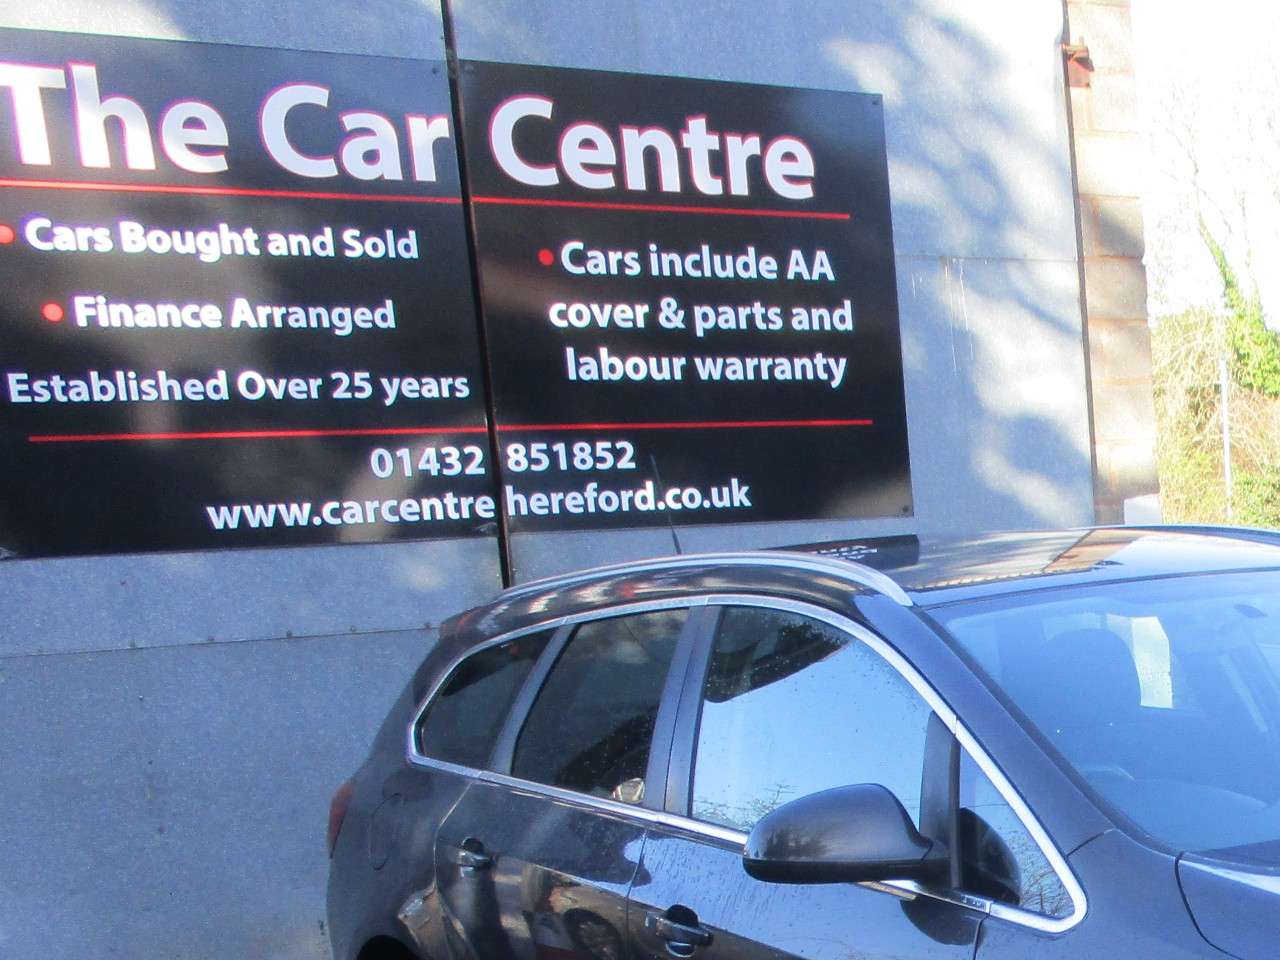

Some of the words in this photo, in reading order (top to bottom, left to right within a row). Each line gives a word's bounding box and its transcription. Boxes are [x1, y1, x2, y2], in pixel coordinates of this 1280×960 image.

[0, 63, 229, 174] The
[260, 83, 450, 182] Car
[489, 96, 815, 201] Centre
[24, 218, 111, 253] Cars
[119, 220, 261, 263] Bought
[267, 228, 335, 259] and
[344, 228, 420, 259] Sold
[560, 241, 641, 277] Cars
[649, 243, 779, 280] include
[786, 249, 835, 282] AA
[74, 296, 222, 329] Finance
[231, 298, 397, 337] Arranged
[548, 301, 650, 330] cover
[658, 297, 686, 331] &
[694, 304, 784, 338] parts
[791, 300, 854, 331] and
[7, 370, 230, 403] Established
[238, 373, 322, 401] Over
[330, 371, 373, 400] 25
[381, 374, 470, 406] years
[566, 347, 687, 382] labour
[694, 352, 848, 389] warranty
[370, 446, 486, 479] 01432
[506, 440, 637, 473] 851852
